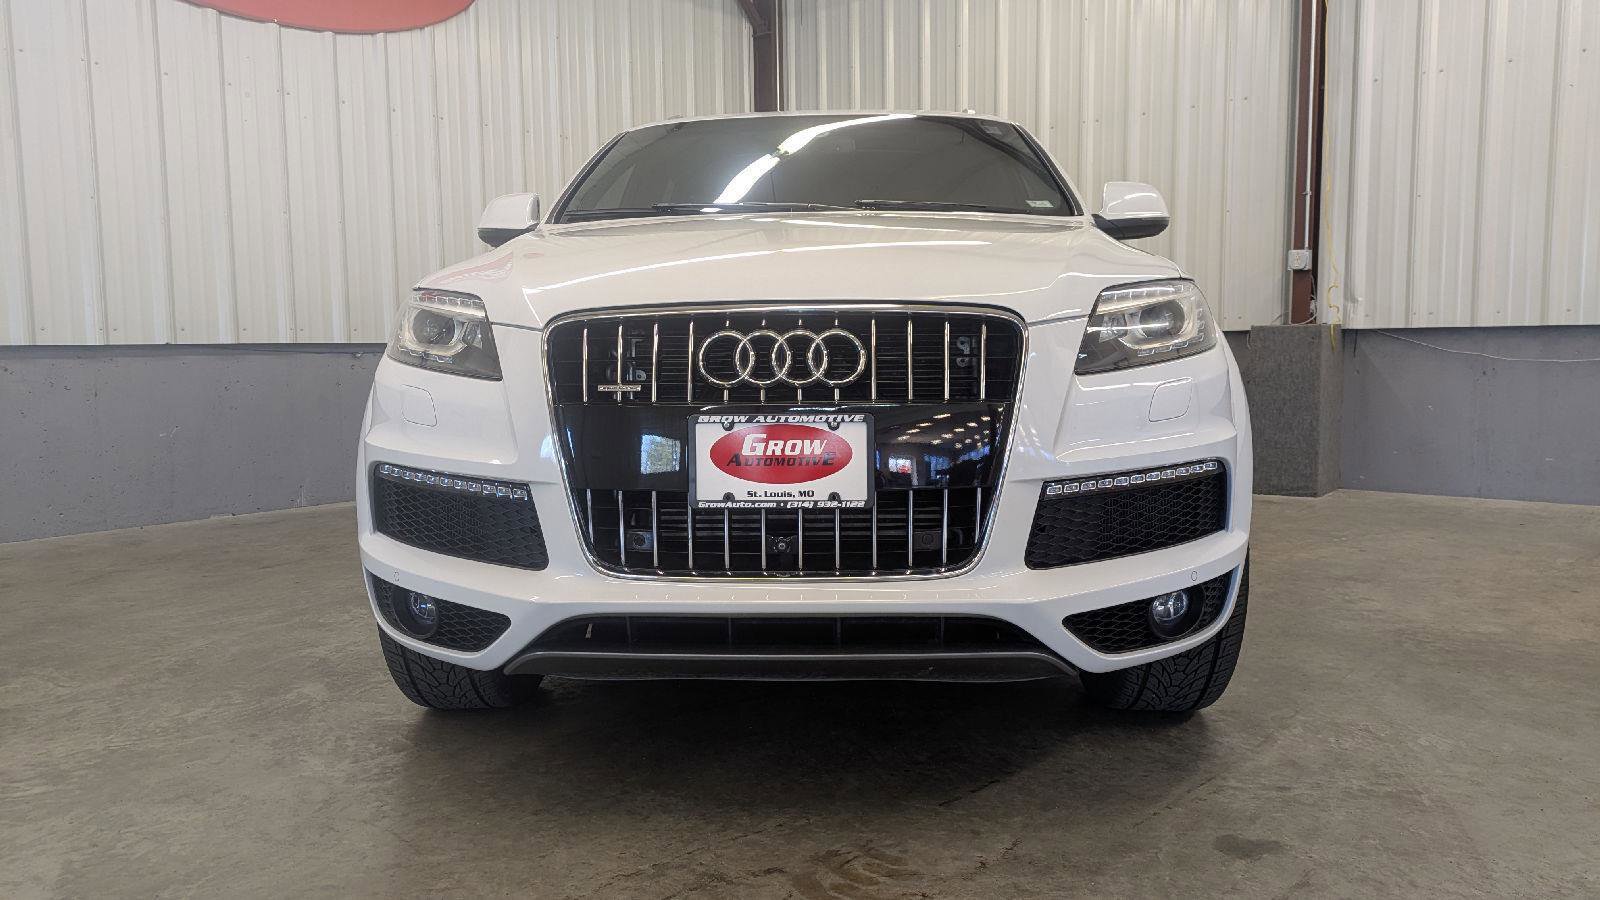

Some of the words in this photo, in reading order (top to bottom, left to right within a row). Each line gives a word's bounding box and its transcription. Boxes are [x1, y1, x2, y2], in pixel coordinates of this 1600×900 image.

[697, 415, 749, 423] GROW
[753, 414, 865, 423] AUTOMOTIVE
[742, 433, 827, 456] GROW
[726, 452, 836, 467] AUTOMOTIVE
[747, 490, 762, 498] St.
[764, 490, 796, 499] Louis,
[798, 490, 815, 498] MO
[786, 501, 814, 509] (314)
[816, 500, 866, 508] 932-1122
